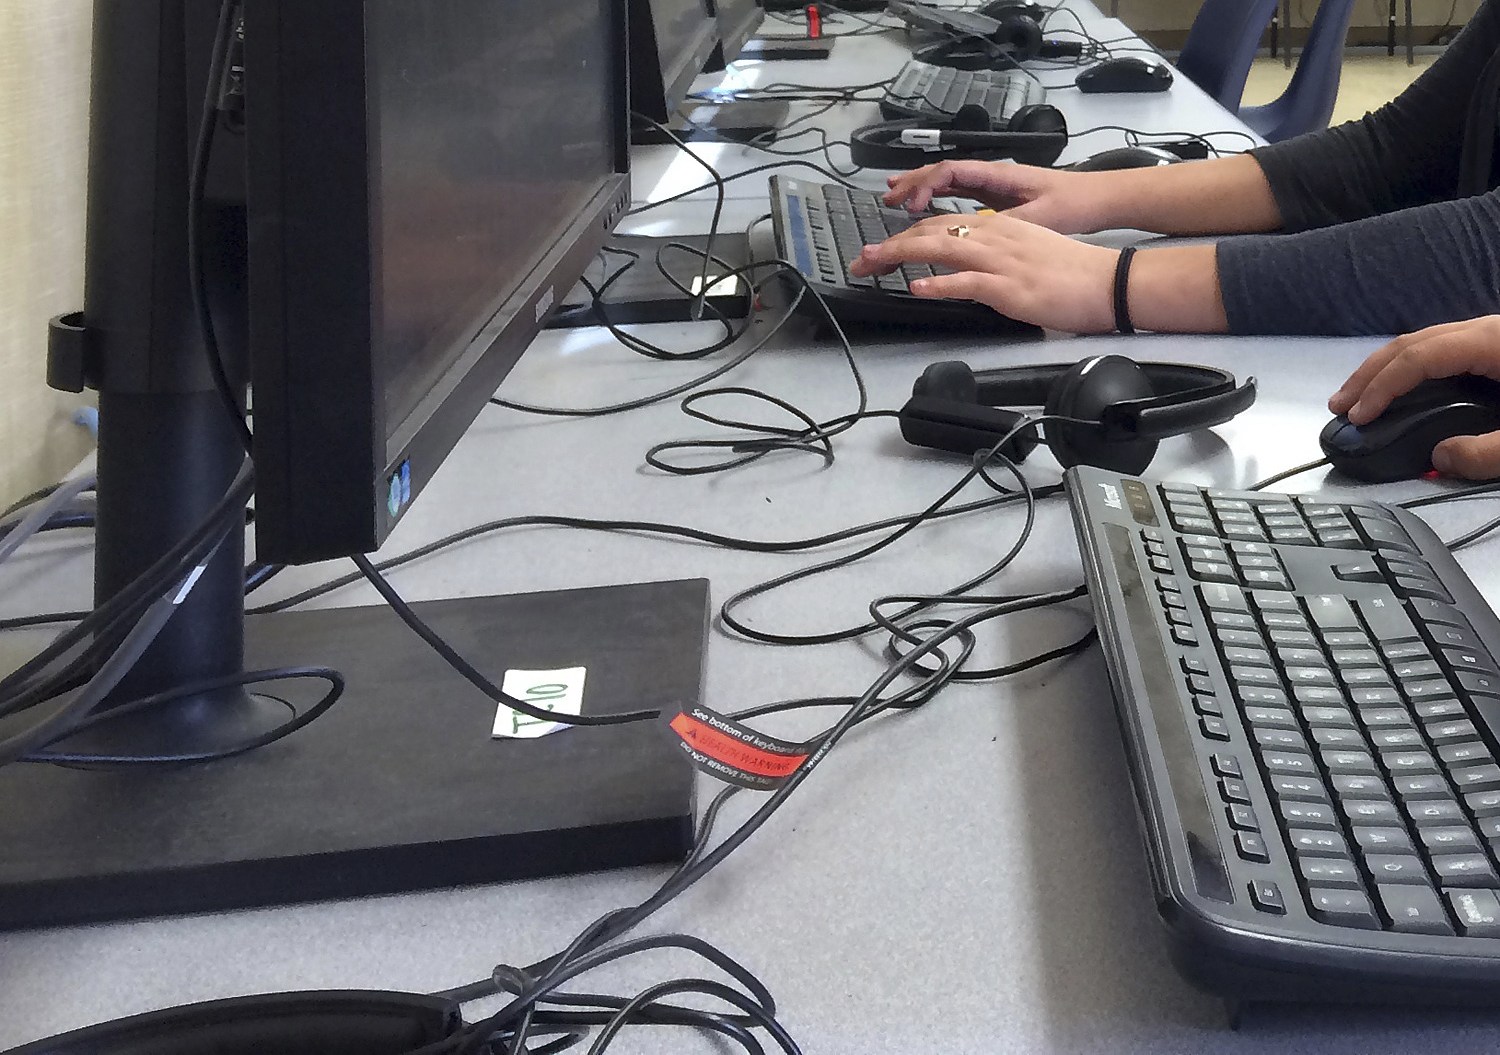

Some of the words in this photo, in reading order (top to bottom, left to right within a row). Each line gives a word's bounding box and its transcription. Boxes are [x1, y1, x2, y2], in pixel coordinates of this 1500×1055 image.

[691, 708, 708, 721] See
[708, 716, 742, 737] bottom
[742, 734, 754, 742] of
[753, 738, 795, 753] keyboard
[680, 741, 690, 753] DO
[691, 751, 707, 764] NOT
[707, 759, 738, 778] REMOVE
[738, 772, 755, 783] THIS
[699, 736, 741, 760] HEALTH
[741, 752, 790, 772] WARNING
